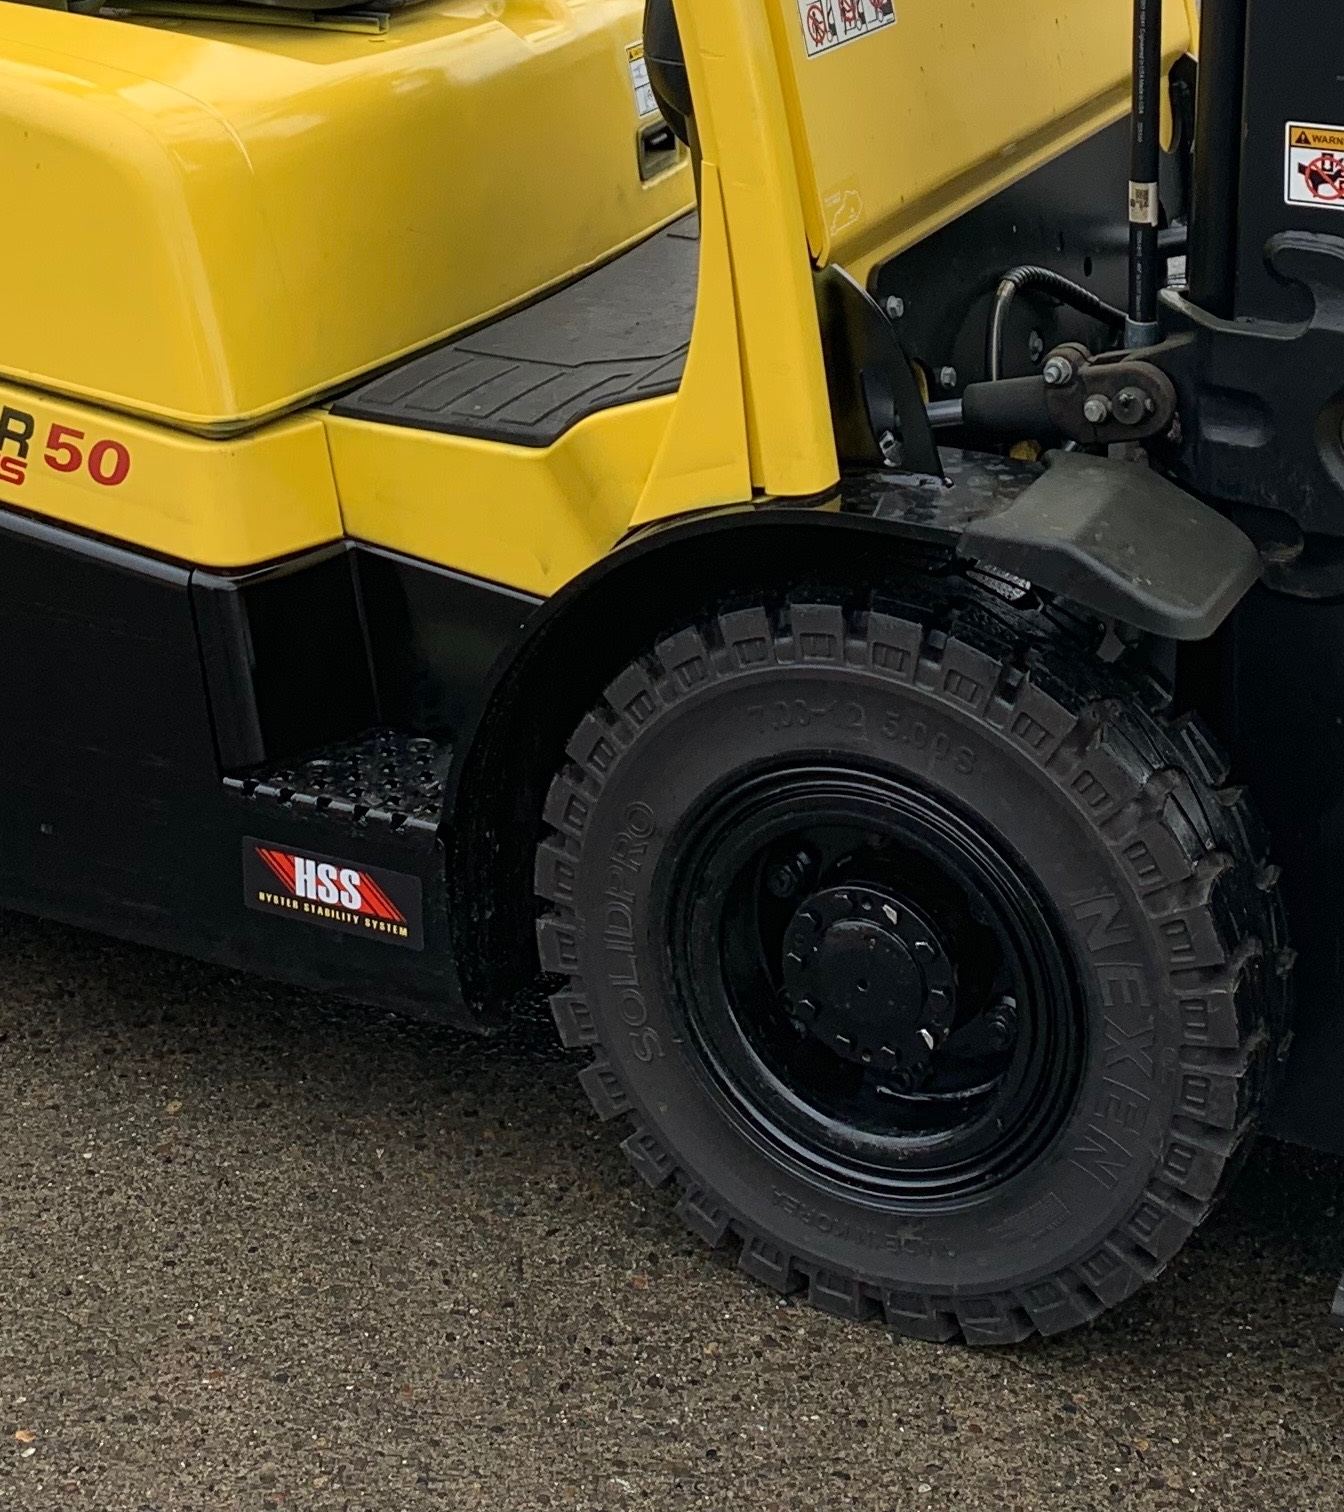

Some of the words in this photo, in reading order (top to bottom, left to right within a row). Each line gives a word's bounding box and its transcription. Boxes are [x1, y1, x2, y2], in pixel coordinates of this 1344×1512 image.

[44, 422, 131, 486] 50
[258, 891, 299, 910] HYSTER
[303, 903, 360, 925] STABILITY
[364, 917, 408, 938] SYSTEM
[294, 856, 362, 911] HSS
[603, 800, 661, 1065] SOLIDPRO
[1071, 892, 1161, 1194] NEXEN
